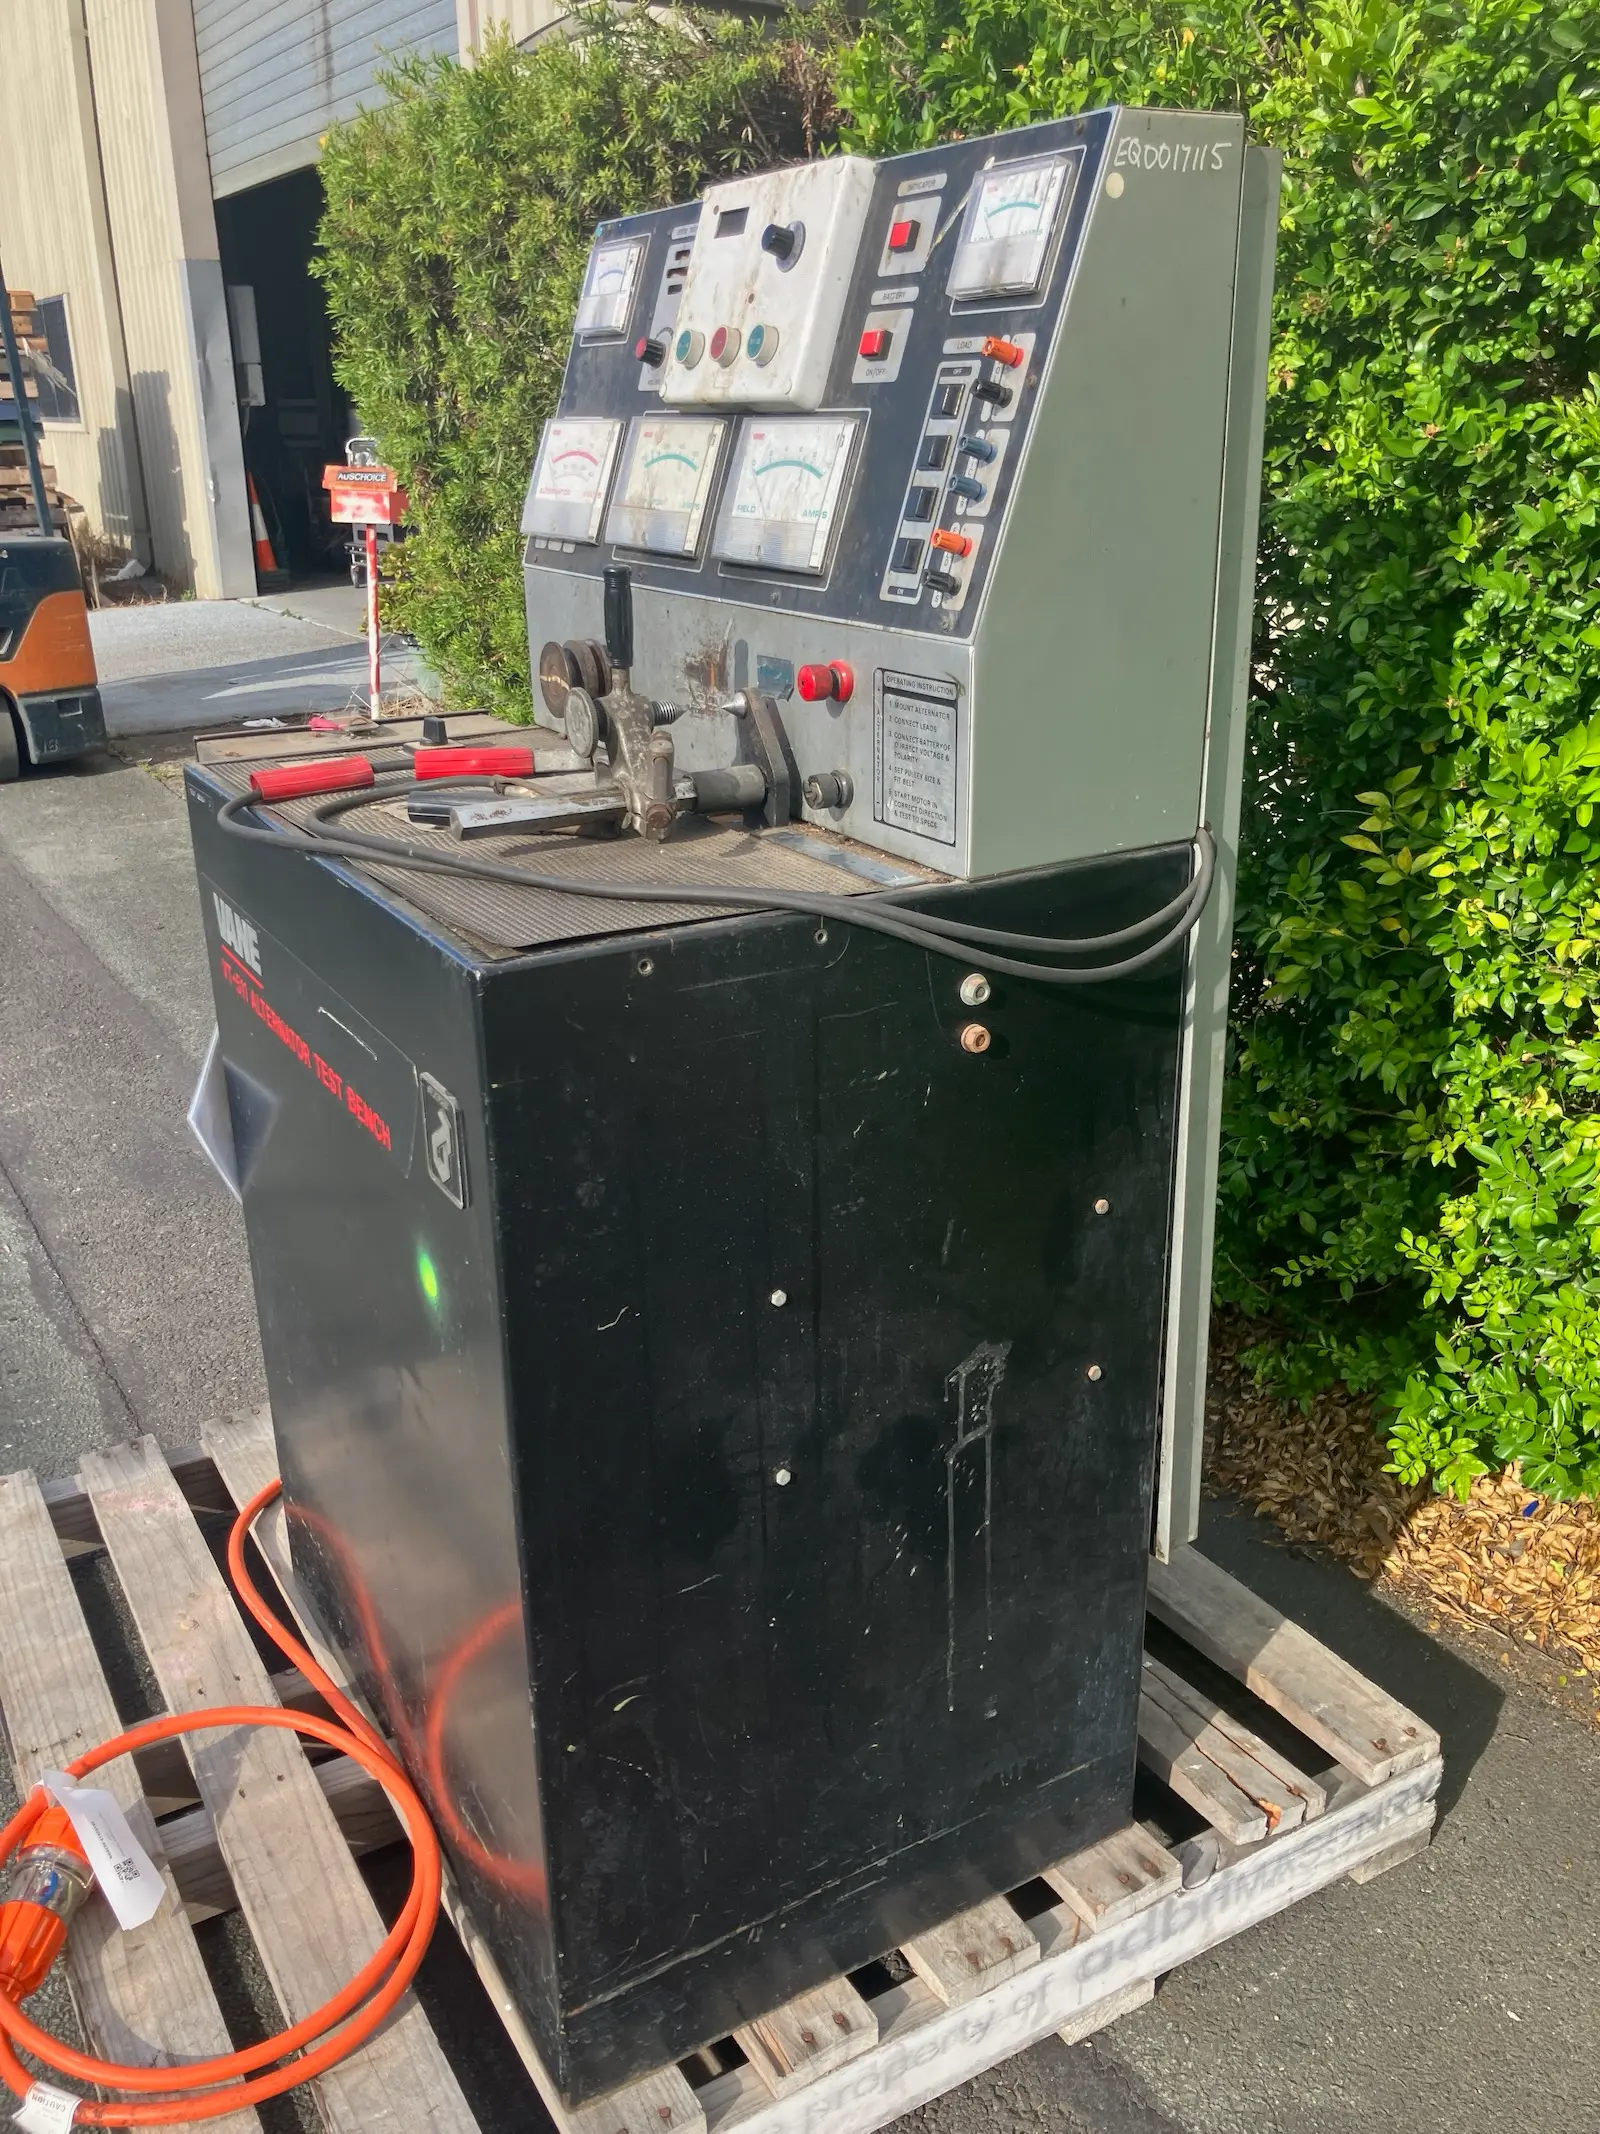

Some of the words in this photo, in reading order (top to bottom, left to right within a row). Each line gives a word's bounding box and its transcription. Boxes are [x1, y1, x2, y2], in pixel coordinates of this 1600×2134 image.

[882, 290, 906, 301] BATTERY
[956, 340, 973, 350] LOAD
[865, 366, 887, 378] ON/OFF
[337, 472, 387, 483] AUSCHOICE
[736, 504, 757, 514] FIELD
[802, 509, 828, 519] AMPS
[886, 675, 915, 687] OPERATING
[916, 682, 954, 696] INSTRUCTION
[894, 701, 914, 712] MOUNT
[915, 706, 950, 720] ALTERNATOR
[894, 716, 919, 728] CONNECT
[920, 722, 937, 733] LEADS
[894, 731, 919, 743] CONNECT
[919, 738, 943, 749] BATTERY
[943, 744, 951, 752] OF
[894, 752, 919, 763] POLARITY
[920, 748, 944, 760] VOLTAGE
[894, 766, 903, 775] SET
[904, 769, 924, 781] PULLEY
[924, 774, 936, 785] SIZE
[902, 778, 915, 788] BELT
[894, 790, 910, 801] START
[911, 795, 931, 807] MOTOR
[931, 801, 938, 809] IN
[894, 800, 918, 813] CORRECT
[918, 807, 948, 822] DIRECTION
[899, 811, 912, 821] TEST
[912, 814, 920, 824] TO
[212, 890, 263, 977] VANE
[249, 988, 312, 1069] ALTERNATOR
[313, 1051, 344, 1101] TEST
[345, 1083, 392, 1152] BENCH
[31, 2093, 66, 2113] CAUTION
